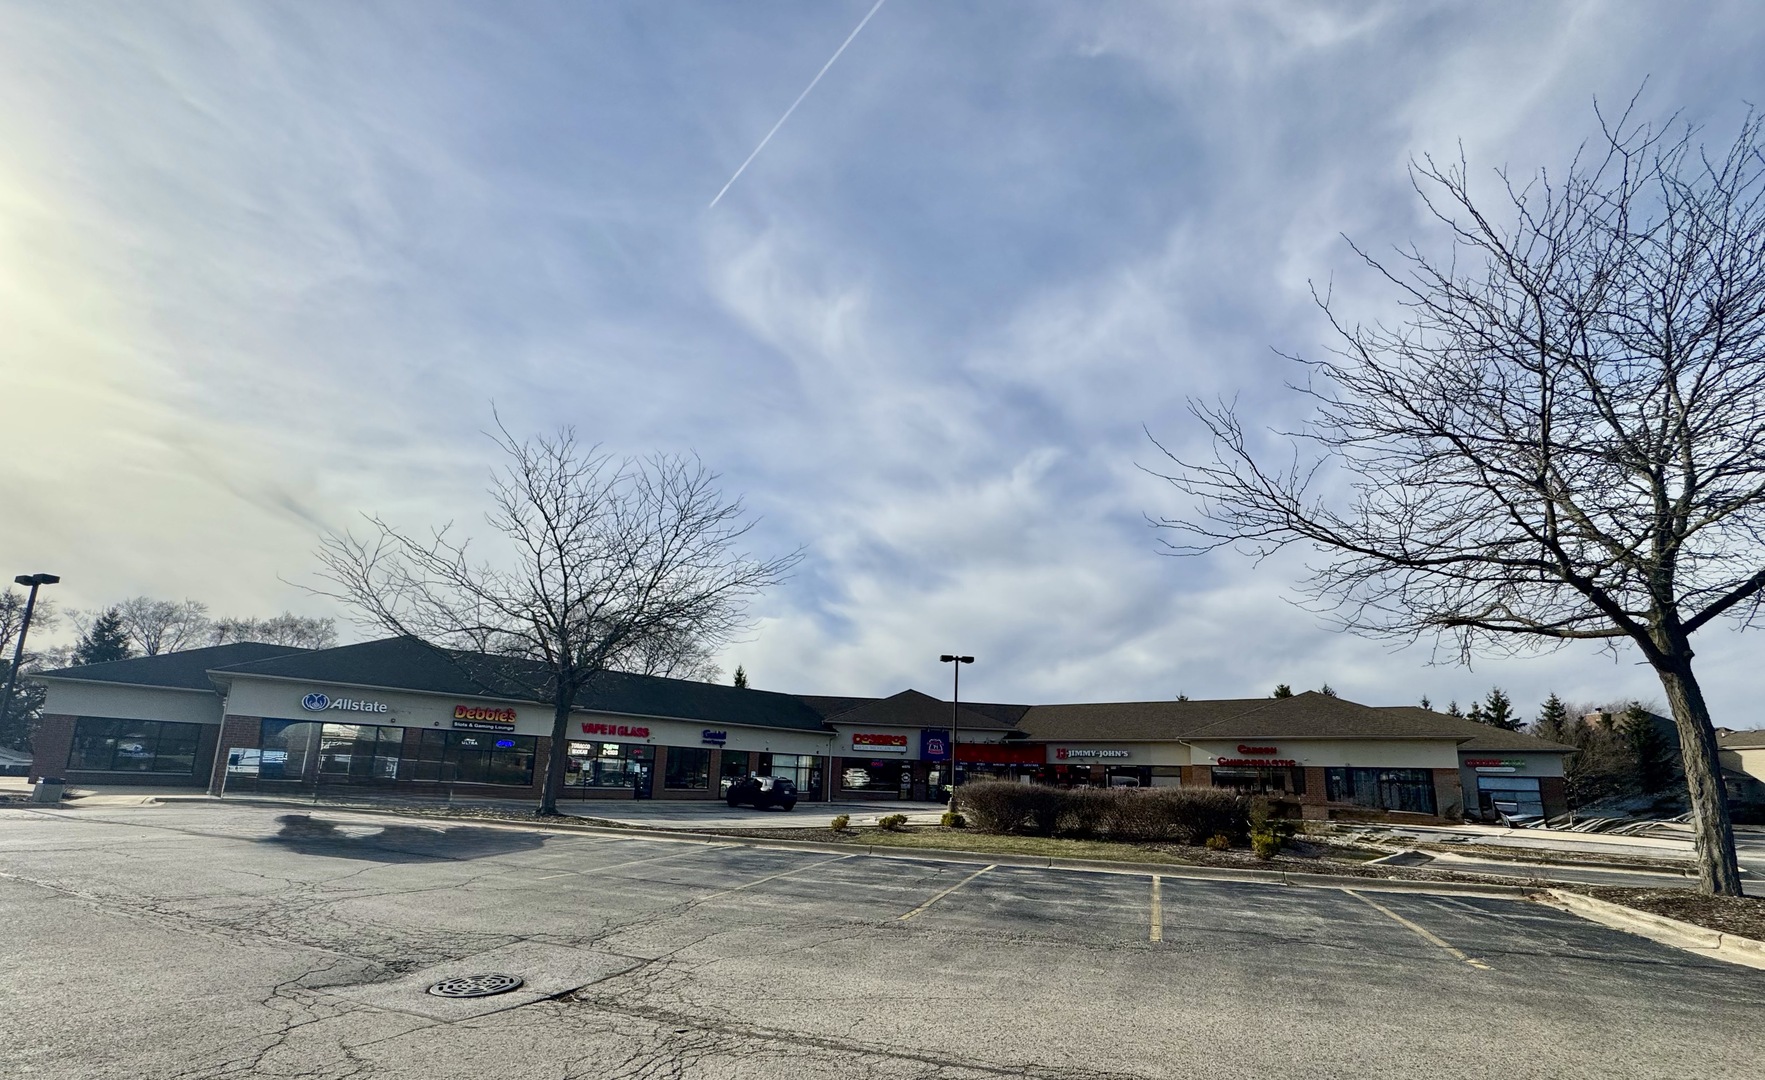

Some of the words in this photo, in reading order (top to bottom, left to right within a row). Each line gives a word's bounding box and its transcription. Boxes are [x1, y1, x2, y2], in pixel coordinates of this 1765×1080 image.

[330, 698, 387, 713] Allstate
[454, 705, 516, 723] Debbie's
[582, 723, 607, 735] VAPE
[608, 724, 617, 735] N
[618, 725, 650, 738] GLASS
[1068, 750, 1096, 758] JIMMY
[1099, 750, 1129, 758] JOHN'S
